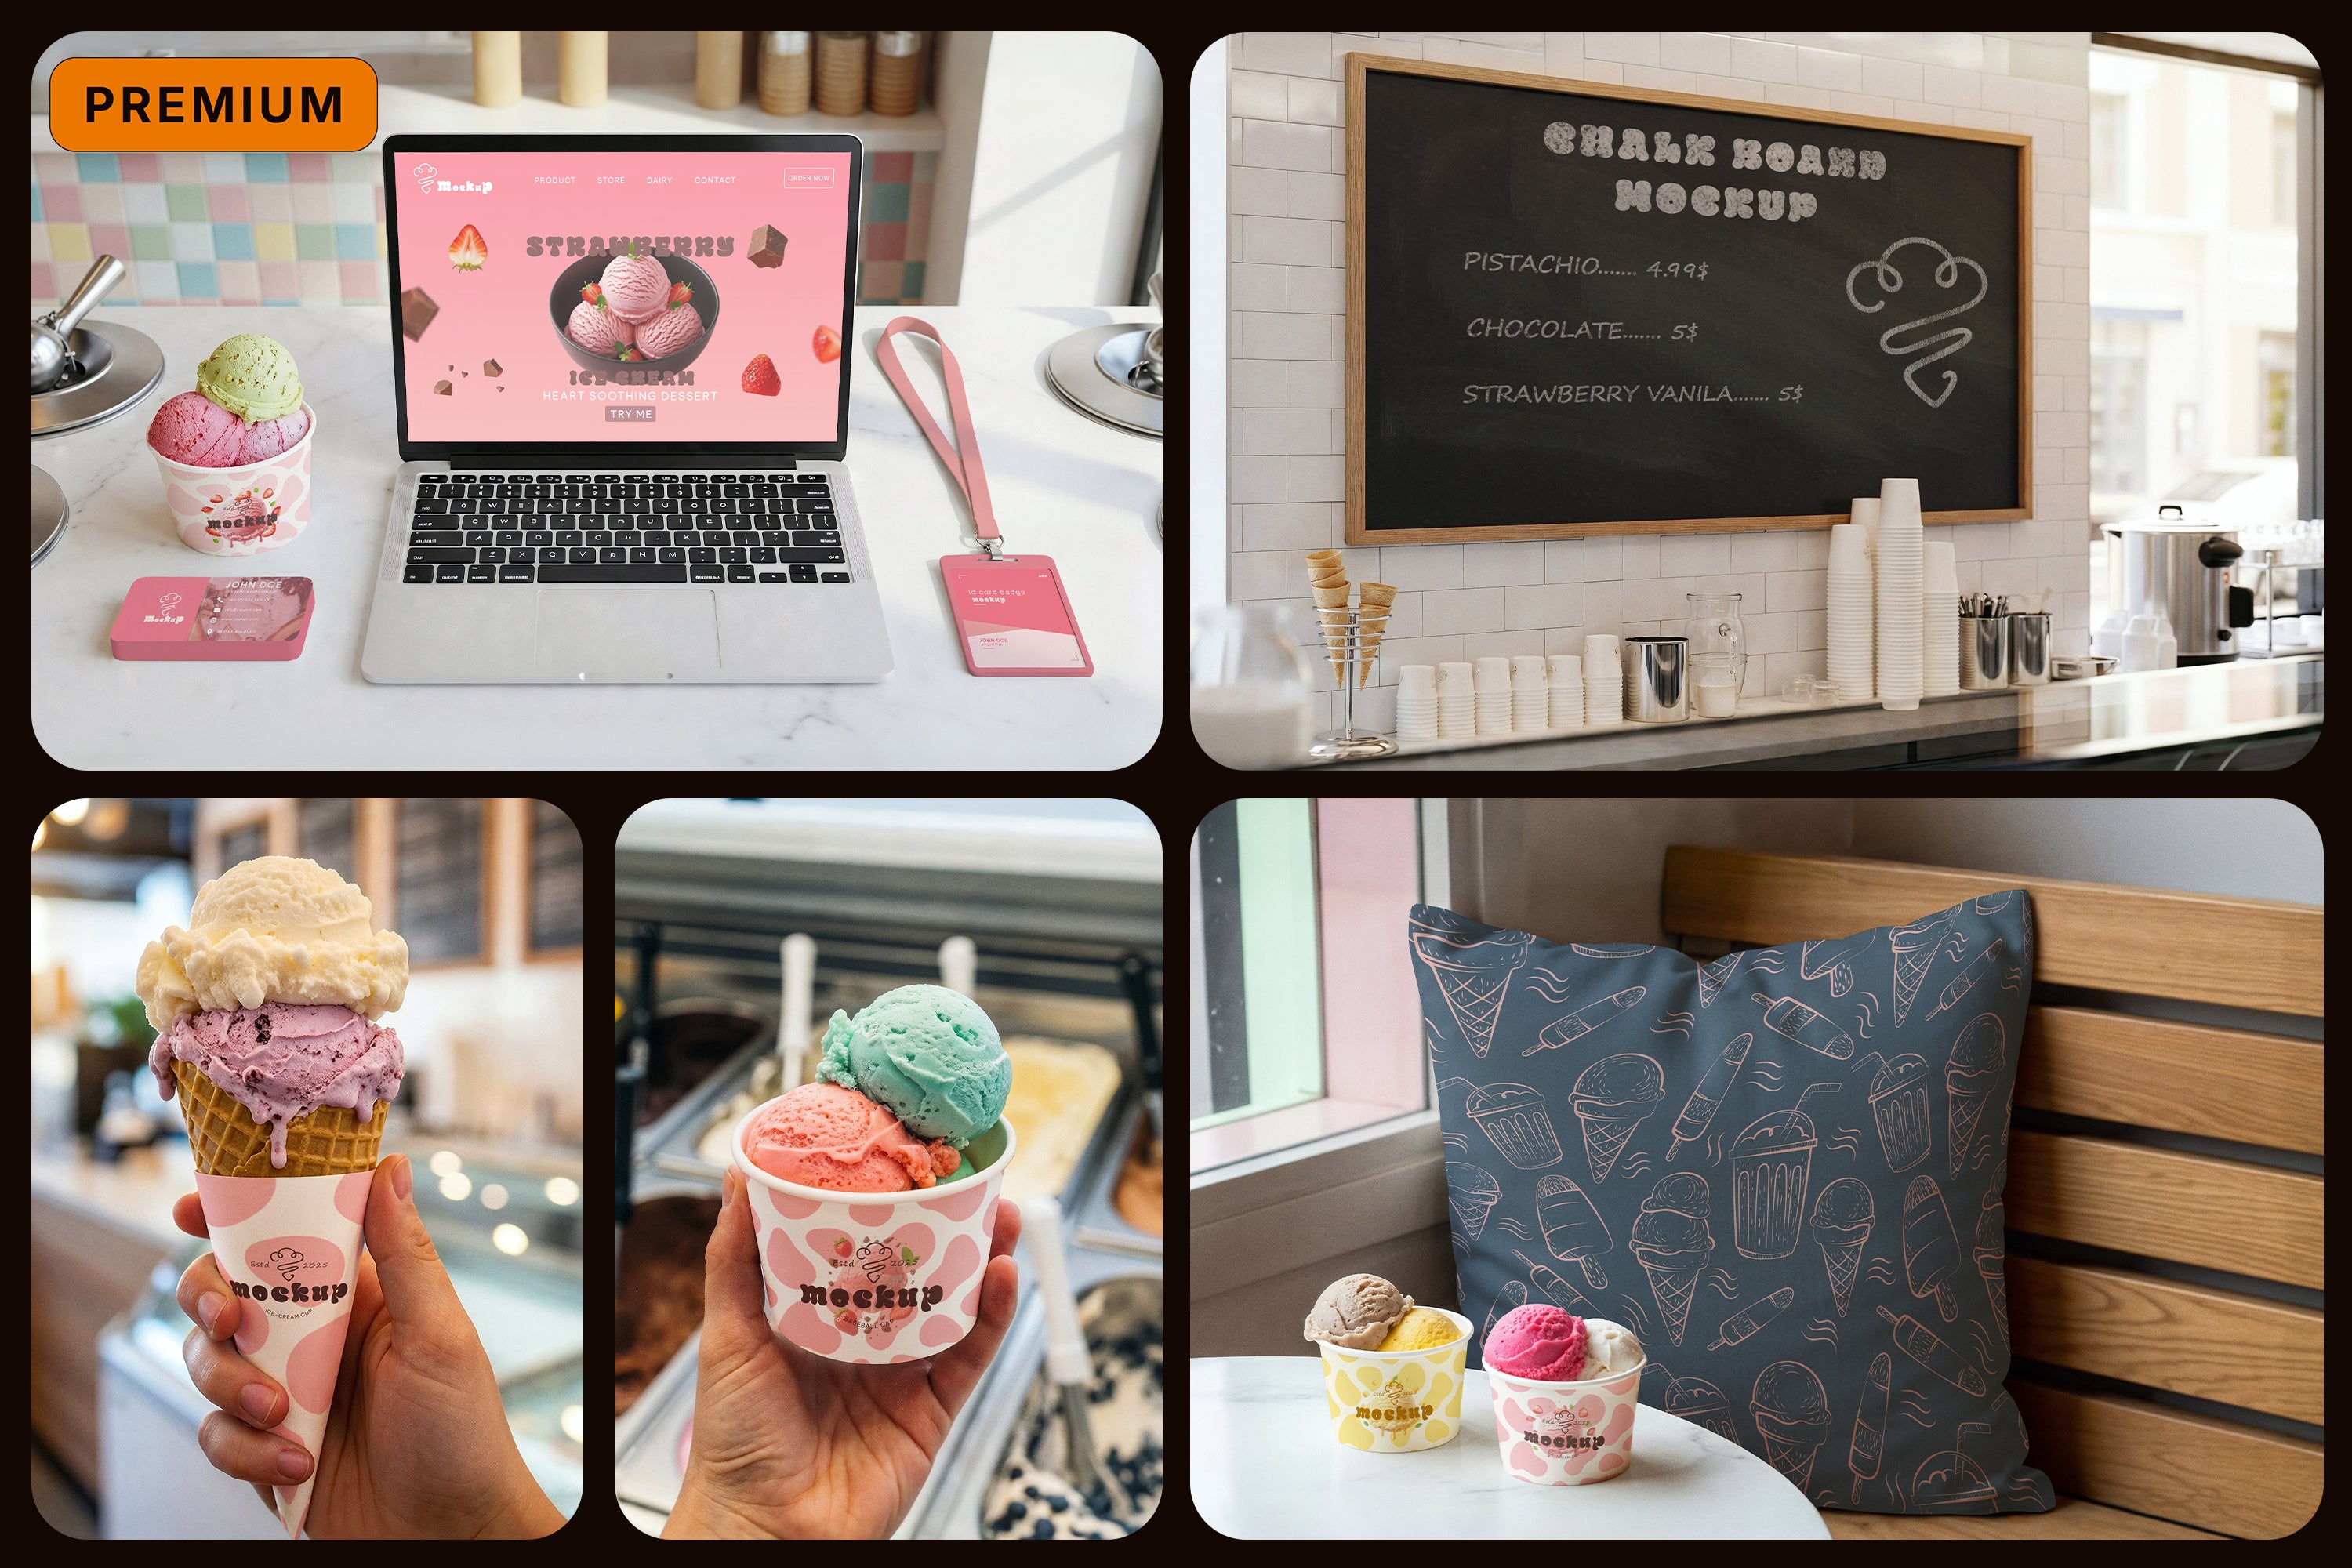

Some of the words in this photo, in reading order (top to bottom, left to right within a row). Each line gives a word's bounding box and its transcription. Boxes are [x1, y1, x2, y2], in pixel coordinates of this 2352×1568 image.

[1543, 121, 1716, 167] CHALK
[1732, 138, 1886, 180] BOARD
[437, 180, 493, 194] Mockup
[1614, 179, 1817, 222] MOCKUP
[526, 236, 735, 257] STRAWBERRY
[1646, 261, 1709, 281] 4.99$
[1671, 322, 1698, 343] 5$
[569, 370, 608, 386] ICE
[615, 370, 695, 386] CREAM
[543, 390, 585, 401] HEART
[589, 390, 656, 401] SOOTHING
[660, 390, 718, 401] DESSERT
[1463, 384, 1640, 404] STRAWBERRY
[1778, 384, 1804, 404] 5$
[610, 409, 633, 419] TRY
[635, 409, 652, 419] ME
[206, 513, 278, 530] mockup
[833, 1258, 855, 1268] Estd
[890, 1258, 920, 1268] 2025
[229, 1279, 348, 1305] mockup
[800, 1283, 944, 1312] mockup
[265, 1308, 299, 1320] ICE-CREAM
[300, 1308, 313, 1318] CUP
[843, 1316, 879, 1330] BASEBALL
[880, 1318, 894, 1328] CAP
[1356, 1404, 1434, 1421] mockup
[1523, 1430, 1606, 1450] mockup
